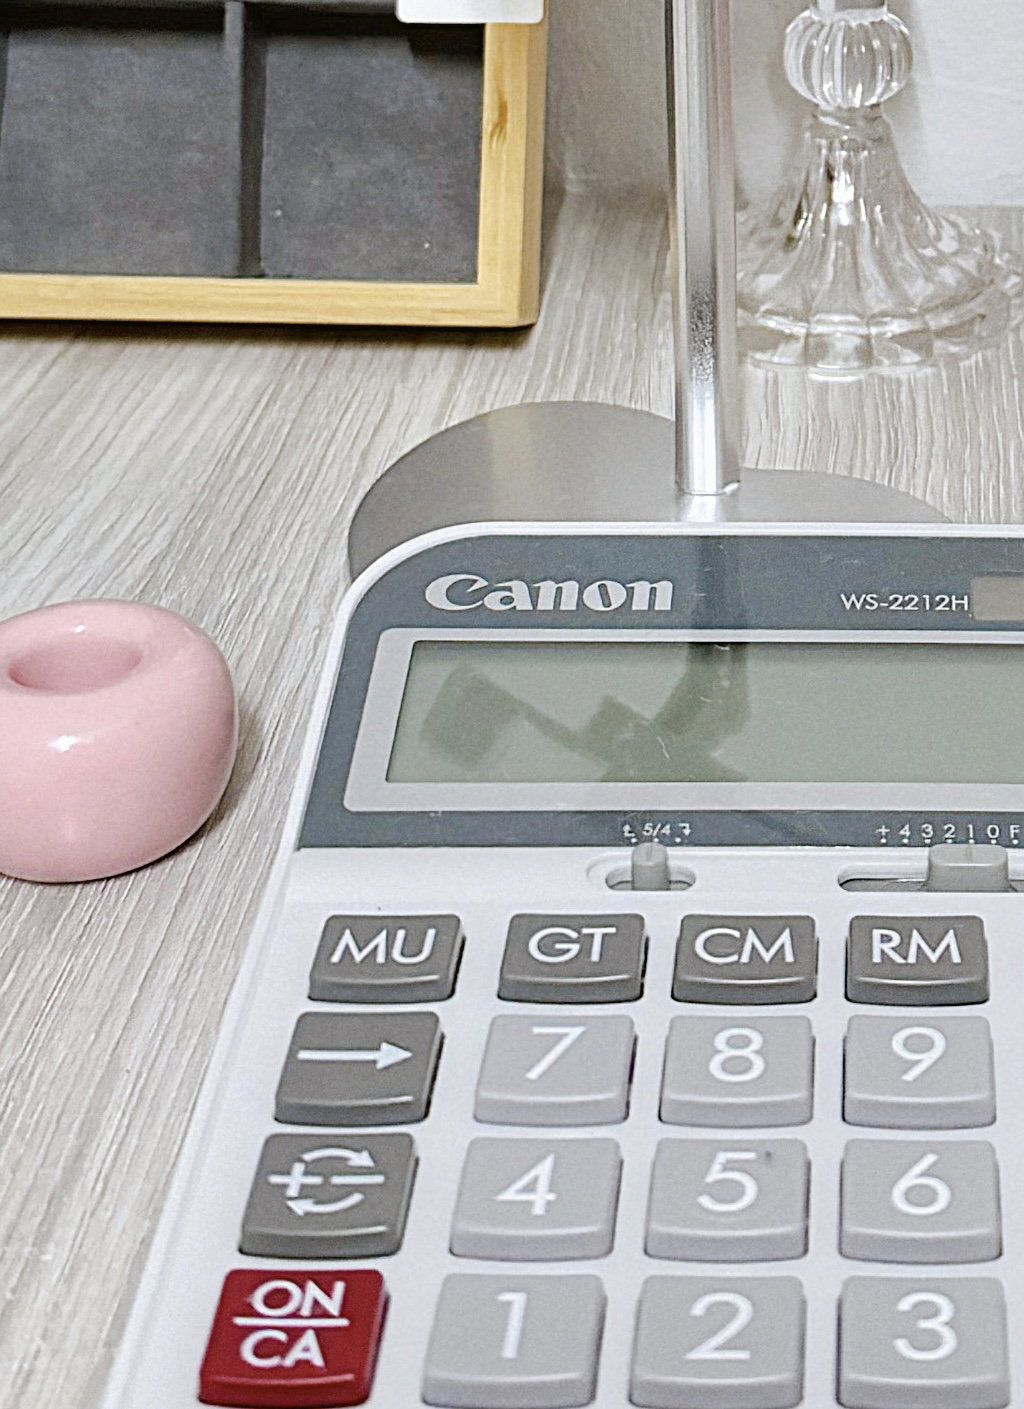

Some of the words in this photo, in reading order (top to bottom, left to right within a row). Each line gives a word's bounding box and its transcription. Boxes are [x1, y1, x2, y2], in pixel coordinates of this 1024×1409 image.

[425, 574, 673, 611] Canon
[841, 593, 969, 612] WS-2212H
[641, 822, 671, 837] 5/4
[330, 928, 436, 964] MU
[528, 927, 617, 963] GT
[694, 927, 795, 964] CM
[872, 928, 962, 964] RM
[525, 1026, 586, 1080] 7
[708, 1027, 765, 1082] 8
[891, 1026, 946, 1082] 9
[495, 1154, 557, 1216] 4
[697, 1151, 757, 1212] 5
[891, 1153, 951, 1216] 6
[250, 1279, 345, 1317] ON
[240, 1329, 325, 1368] CA
[496, 1292, 527, 1359] 1
[685, 1292, 753, 1360] 2
[893, 1292, 957, 1361] 3
